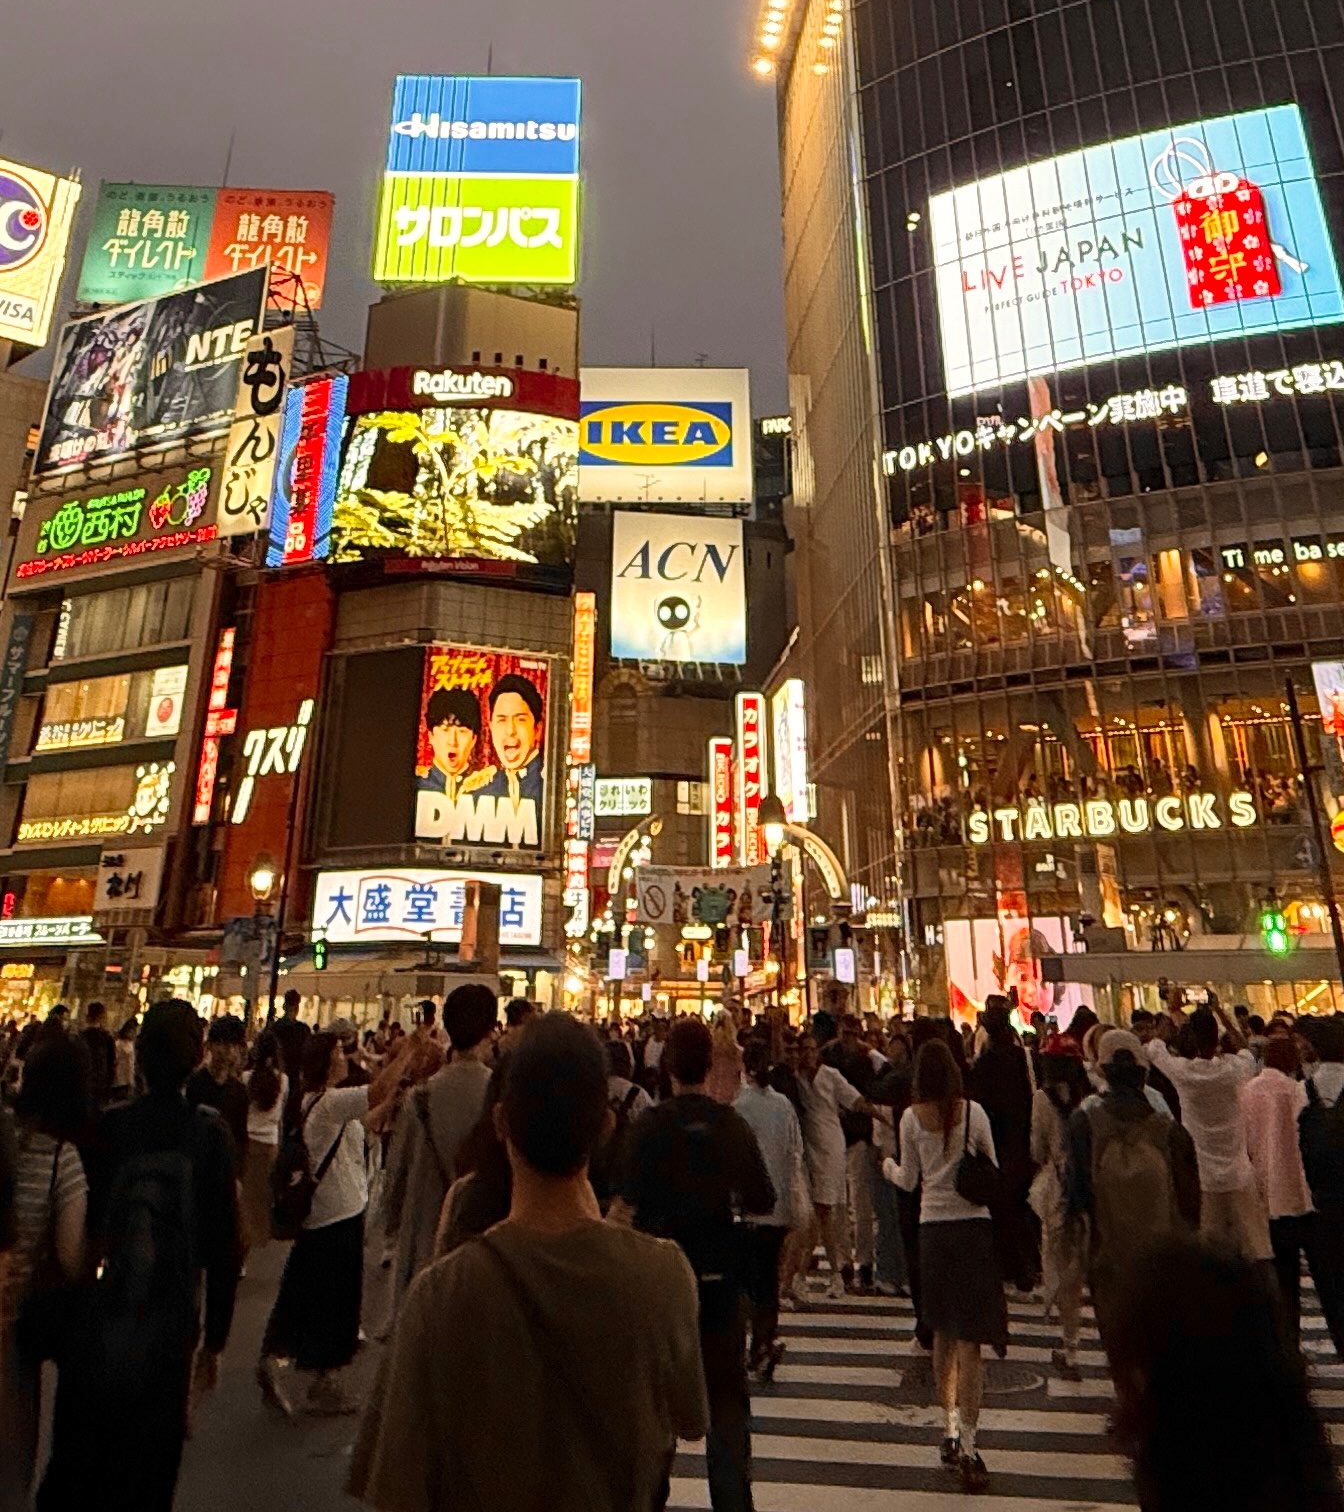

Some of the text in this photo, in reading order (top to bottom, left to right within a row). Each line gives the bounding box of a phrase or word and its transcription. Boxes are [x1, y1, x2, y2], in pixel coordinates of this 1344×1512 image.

[116, 208, 191, 239] 龍角散
[235, 213, 311, 244] 龍角散
[393, 204, 564, 250] サロンパス
[1199, 205, 1249, 286] 御守
[101, 238, 197, 271] ダイレクト
[961, 255, 1025, 293] LIVE
[1036, 226, 1145, 274] JAPAN
[1026, 287, 1057, 304] GUIDE
[1059, 267, 1124, 294] TOKYO
[184, 318, 256, 366] NTE
[413, 368, 514, 397] Rakuten
[223, 334, 287, 526] もんじゃ
[586, 419, 719, 447] IKEA
[81, 501, 143, 545] 西村
[616, 539, 741, 584] ACN
[415, 789, 540, 846] DMM
[715, 810, 732, 868] カラオ
[969, 791, 1258, 846] STARBUCKS
